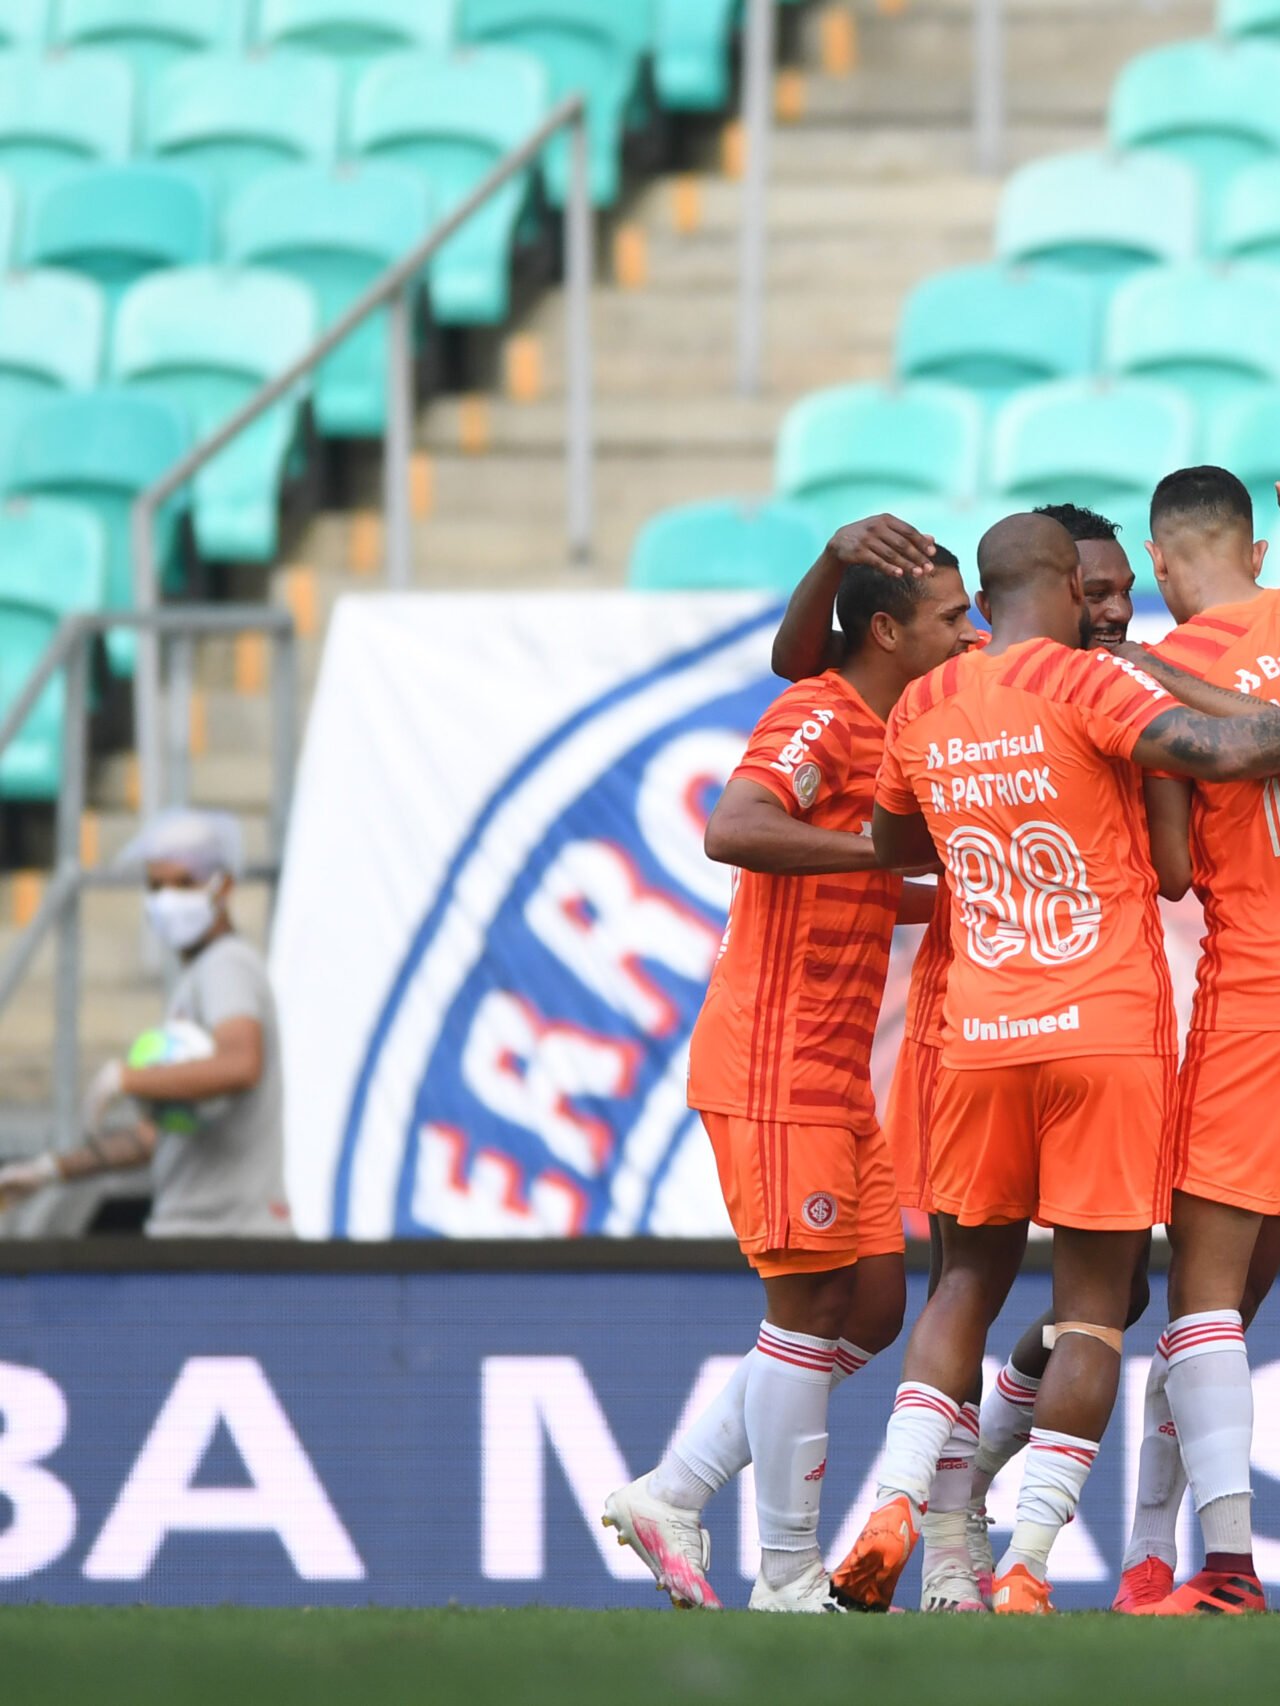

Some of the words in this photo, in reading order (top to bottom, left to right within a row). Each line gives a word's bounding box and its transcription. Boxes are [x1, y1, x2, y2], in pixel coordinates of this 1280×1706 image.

[770, 720, 822, 774] vero
[948, 725, 1044, 765] Banrisul
[946, 820, 1102, 967] 88
[963, 1005, 1080, 1041] Unimed
